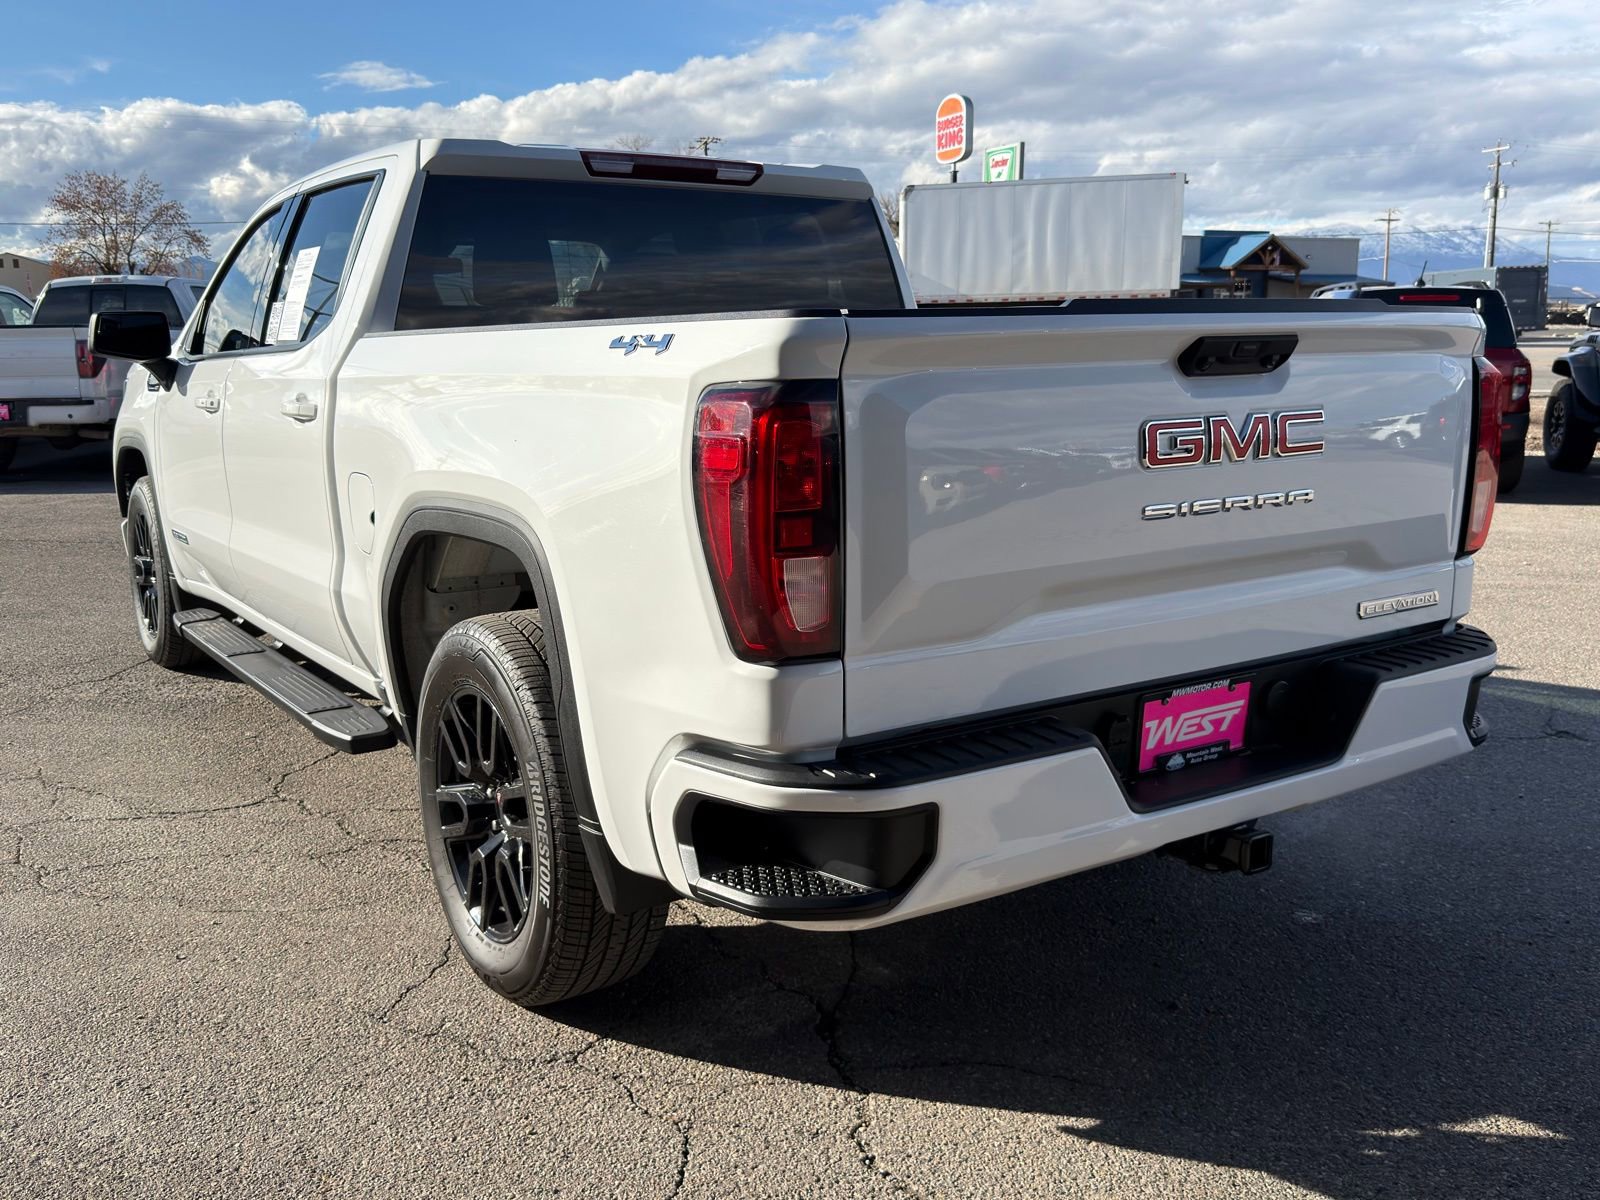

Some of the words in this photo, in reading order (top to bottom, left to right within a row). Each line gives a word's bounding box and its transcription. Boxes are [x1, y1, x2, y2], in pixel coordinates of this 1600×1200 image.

[938, 114, 963, 132] BURGER
[938, 128, 963, 150] KING
[1141, 409, 1325, 469] GMC
[1142, 488, 1316, 521] SIERRA
[1365, 594, 1434, 615] ELEVATION
[1171, 679, 1231, 698] MWMOTOR.COM
[1145, 699, 1245, 750] WEST
[525, 761, 551, 909] BRIDGESTONE
